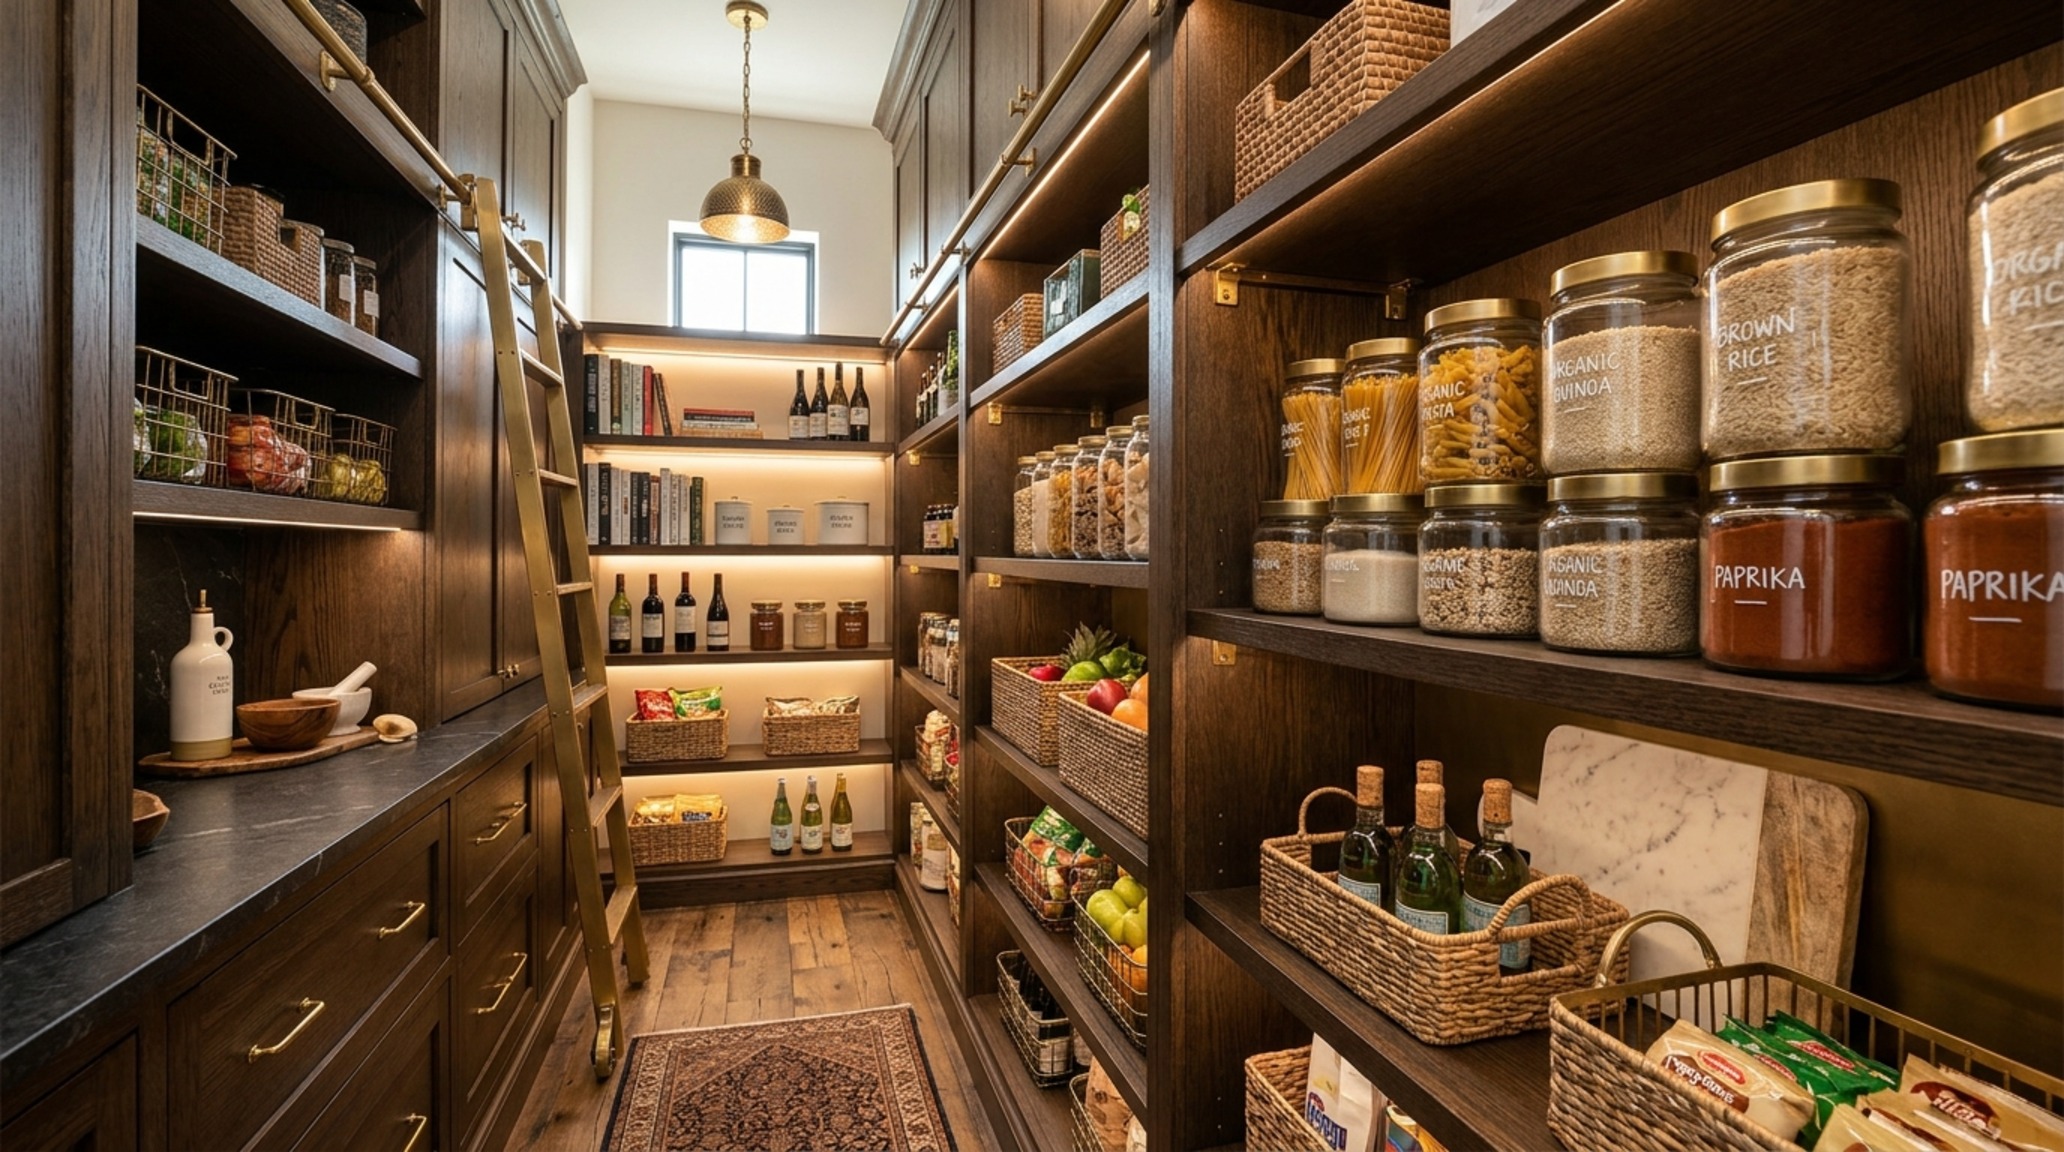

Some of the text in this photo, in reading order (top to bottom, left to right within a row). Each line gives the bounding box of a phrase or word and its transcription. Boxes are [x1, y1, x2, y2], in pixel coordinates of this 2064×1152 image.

[1718, 306, 1795, 348] BROWN
[1728, 343, 1777, 372] RICE
[1714, 565, 1806, 590] PAPRIKA
[1941, 569, 2064, 603] PAPRIKA
